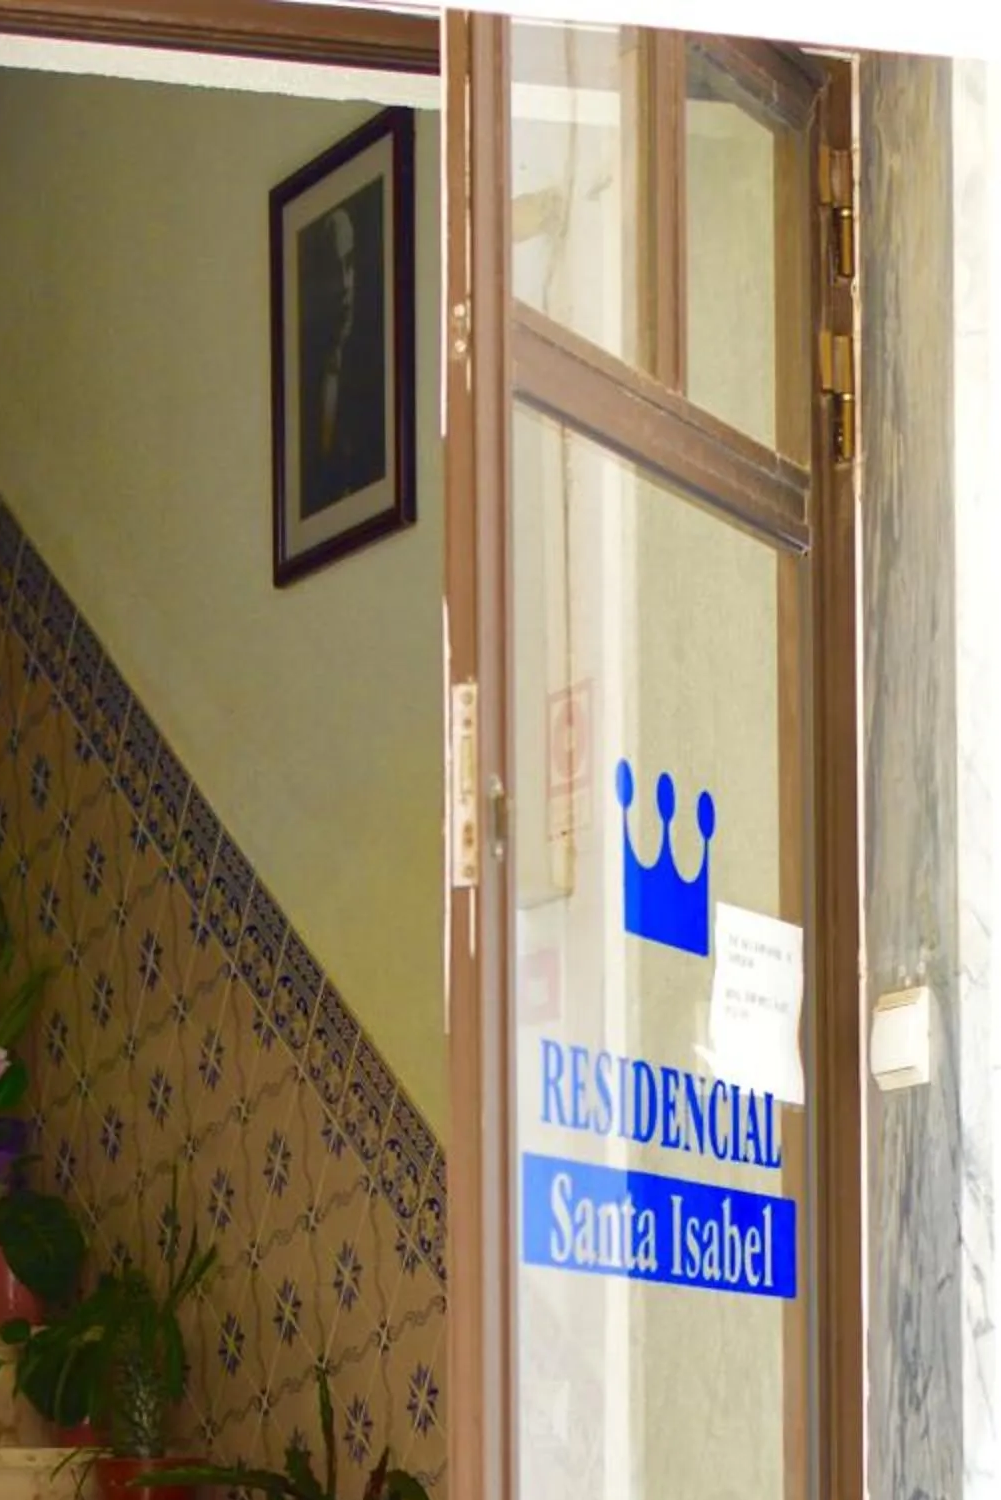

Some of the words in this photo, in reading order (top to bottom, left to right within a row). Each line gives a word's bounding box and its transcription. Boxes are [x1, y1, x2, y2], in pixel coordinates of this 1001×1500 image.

[540, 1038, 781, 1168] RESIDENCIAL
[551, 1172, 658, 1273] Santa
[671, 1195, 774, 1288] Isabel
